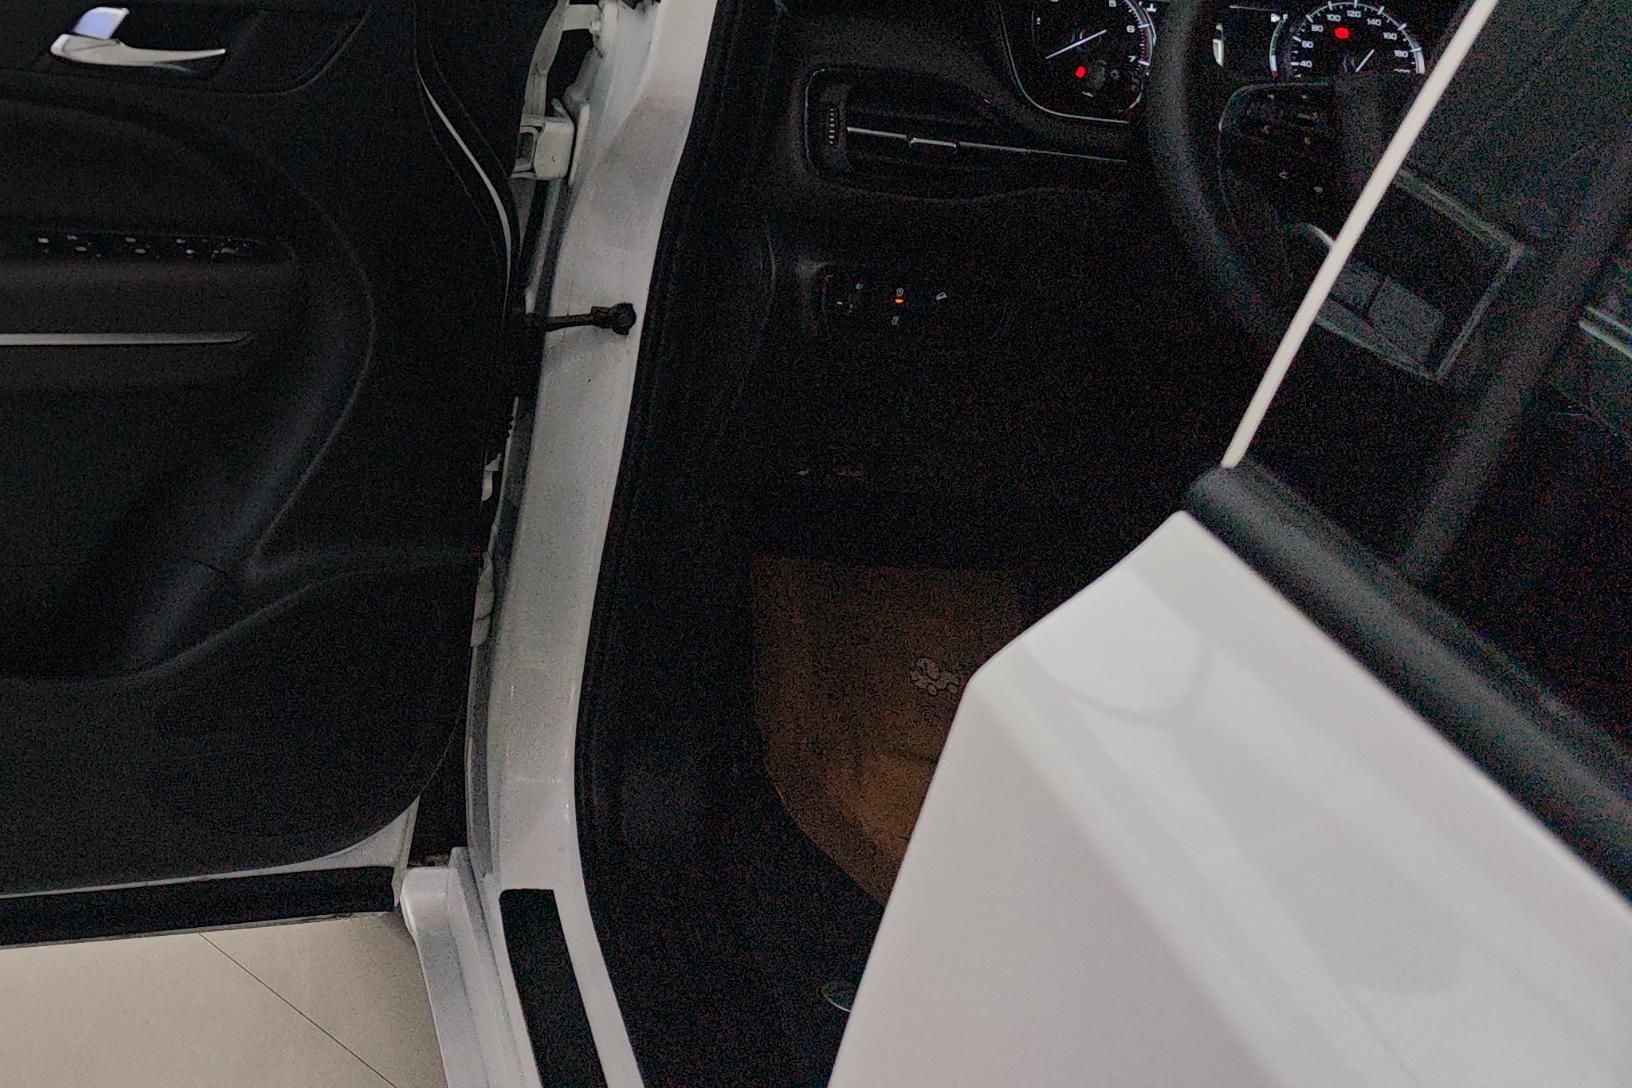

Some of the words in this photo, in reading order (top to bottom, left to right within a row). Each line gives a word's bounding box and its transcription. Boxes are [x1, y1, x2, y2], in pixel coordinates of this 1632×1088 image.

[1326, 13, 1342, 22] 100
[1346, 9, 1362, 18] 120
[1367, 17, 1382, 27] 140
[1311, 24, 1324, 33] 80
[1301, 40, 1314, 49] 60
[1393, 49, 1409, 58] 180
[1128, 55, 1137, 63] 7
[1299, 60, 1313, 68] 40
